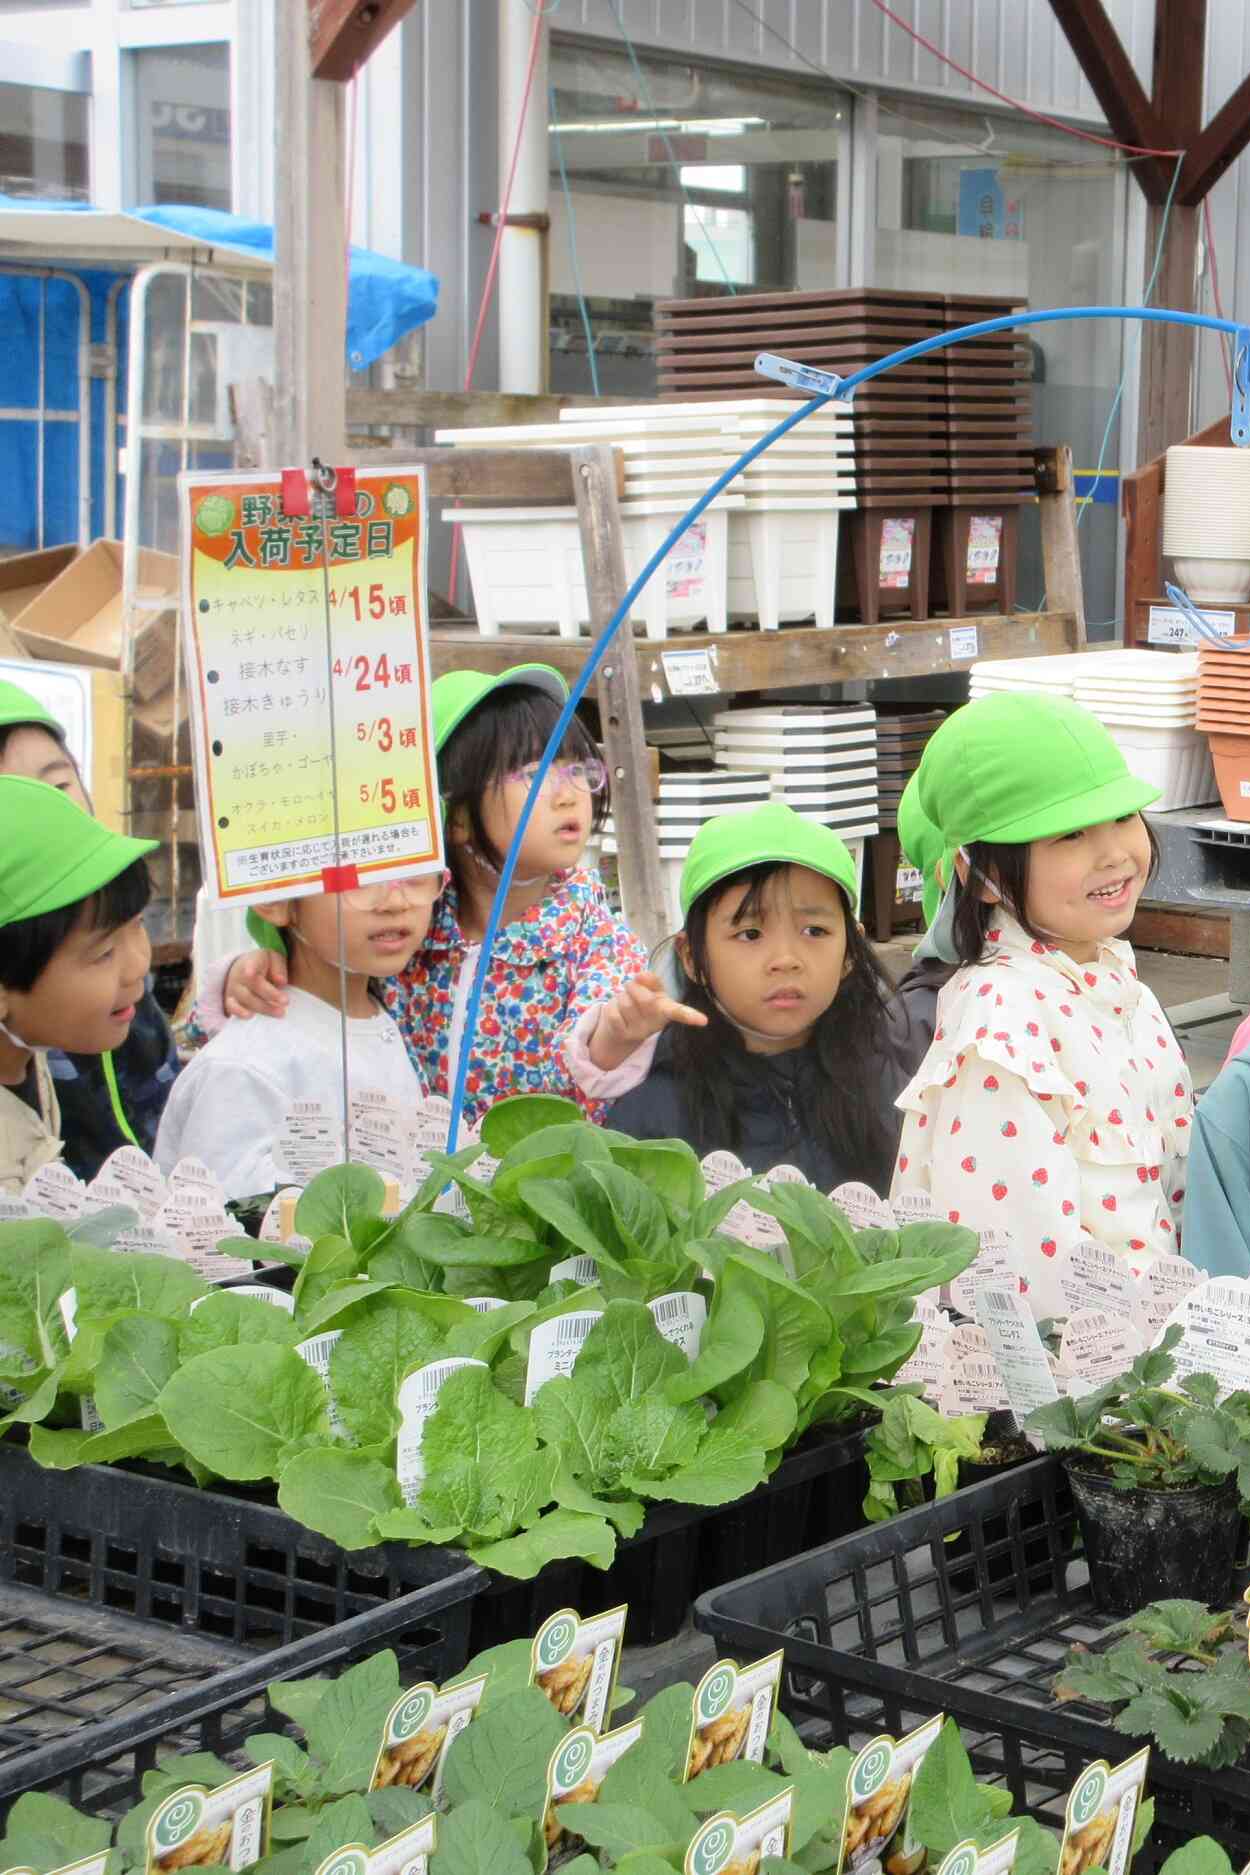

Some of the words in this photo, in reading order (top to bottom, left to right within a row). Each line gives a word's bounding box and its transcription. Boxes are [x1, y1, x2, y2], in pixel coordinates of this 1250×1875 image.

[223, 520, 393, 571] 入荷予定日
